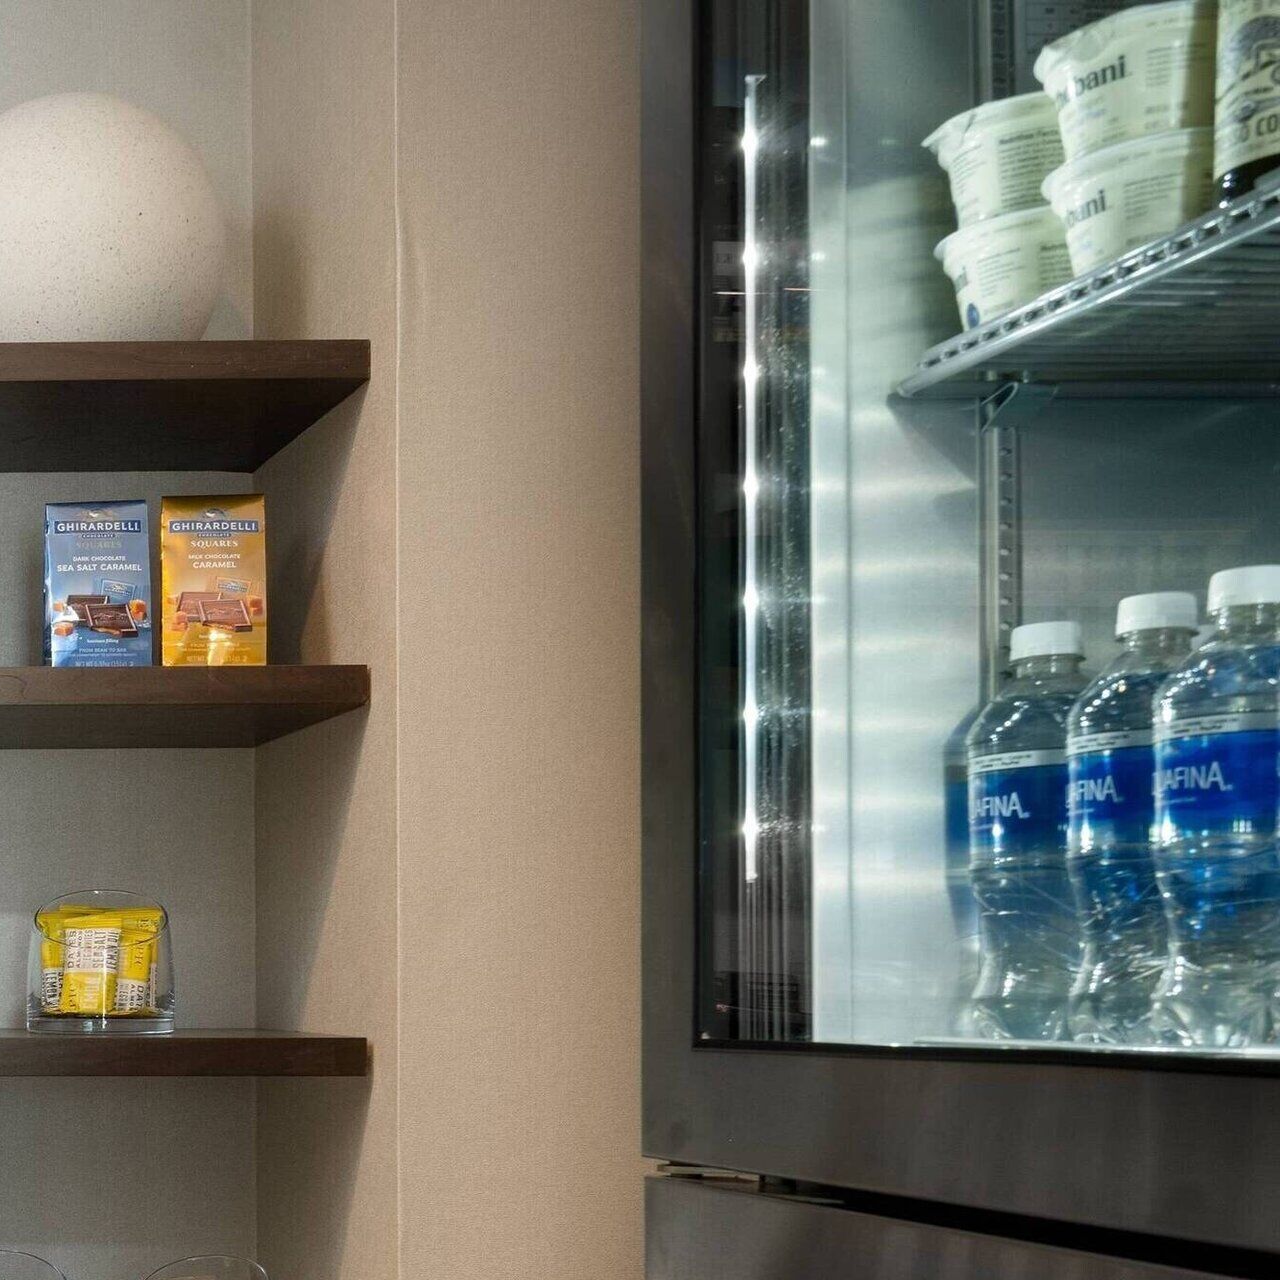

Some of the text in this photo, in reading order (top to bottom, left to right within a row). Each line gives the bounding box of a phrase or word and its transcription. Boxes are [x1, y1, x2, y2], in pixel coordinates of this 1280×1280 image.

[56, 521, 140, 532] GHIRARDELLI
[172, 521, 256, 531] GHIRARDELLI
[190, 540, 239, 549] SQUARES
[56, 563, 142, 572] SEA SALT CARAMEL
[192, 561, 237, 569] CARAMEL
[972, 791, 1022, 819] AFINA
